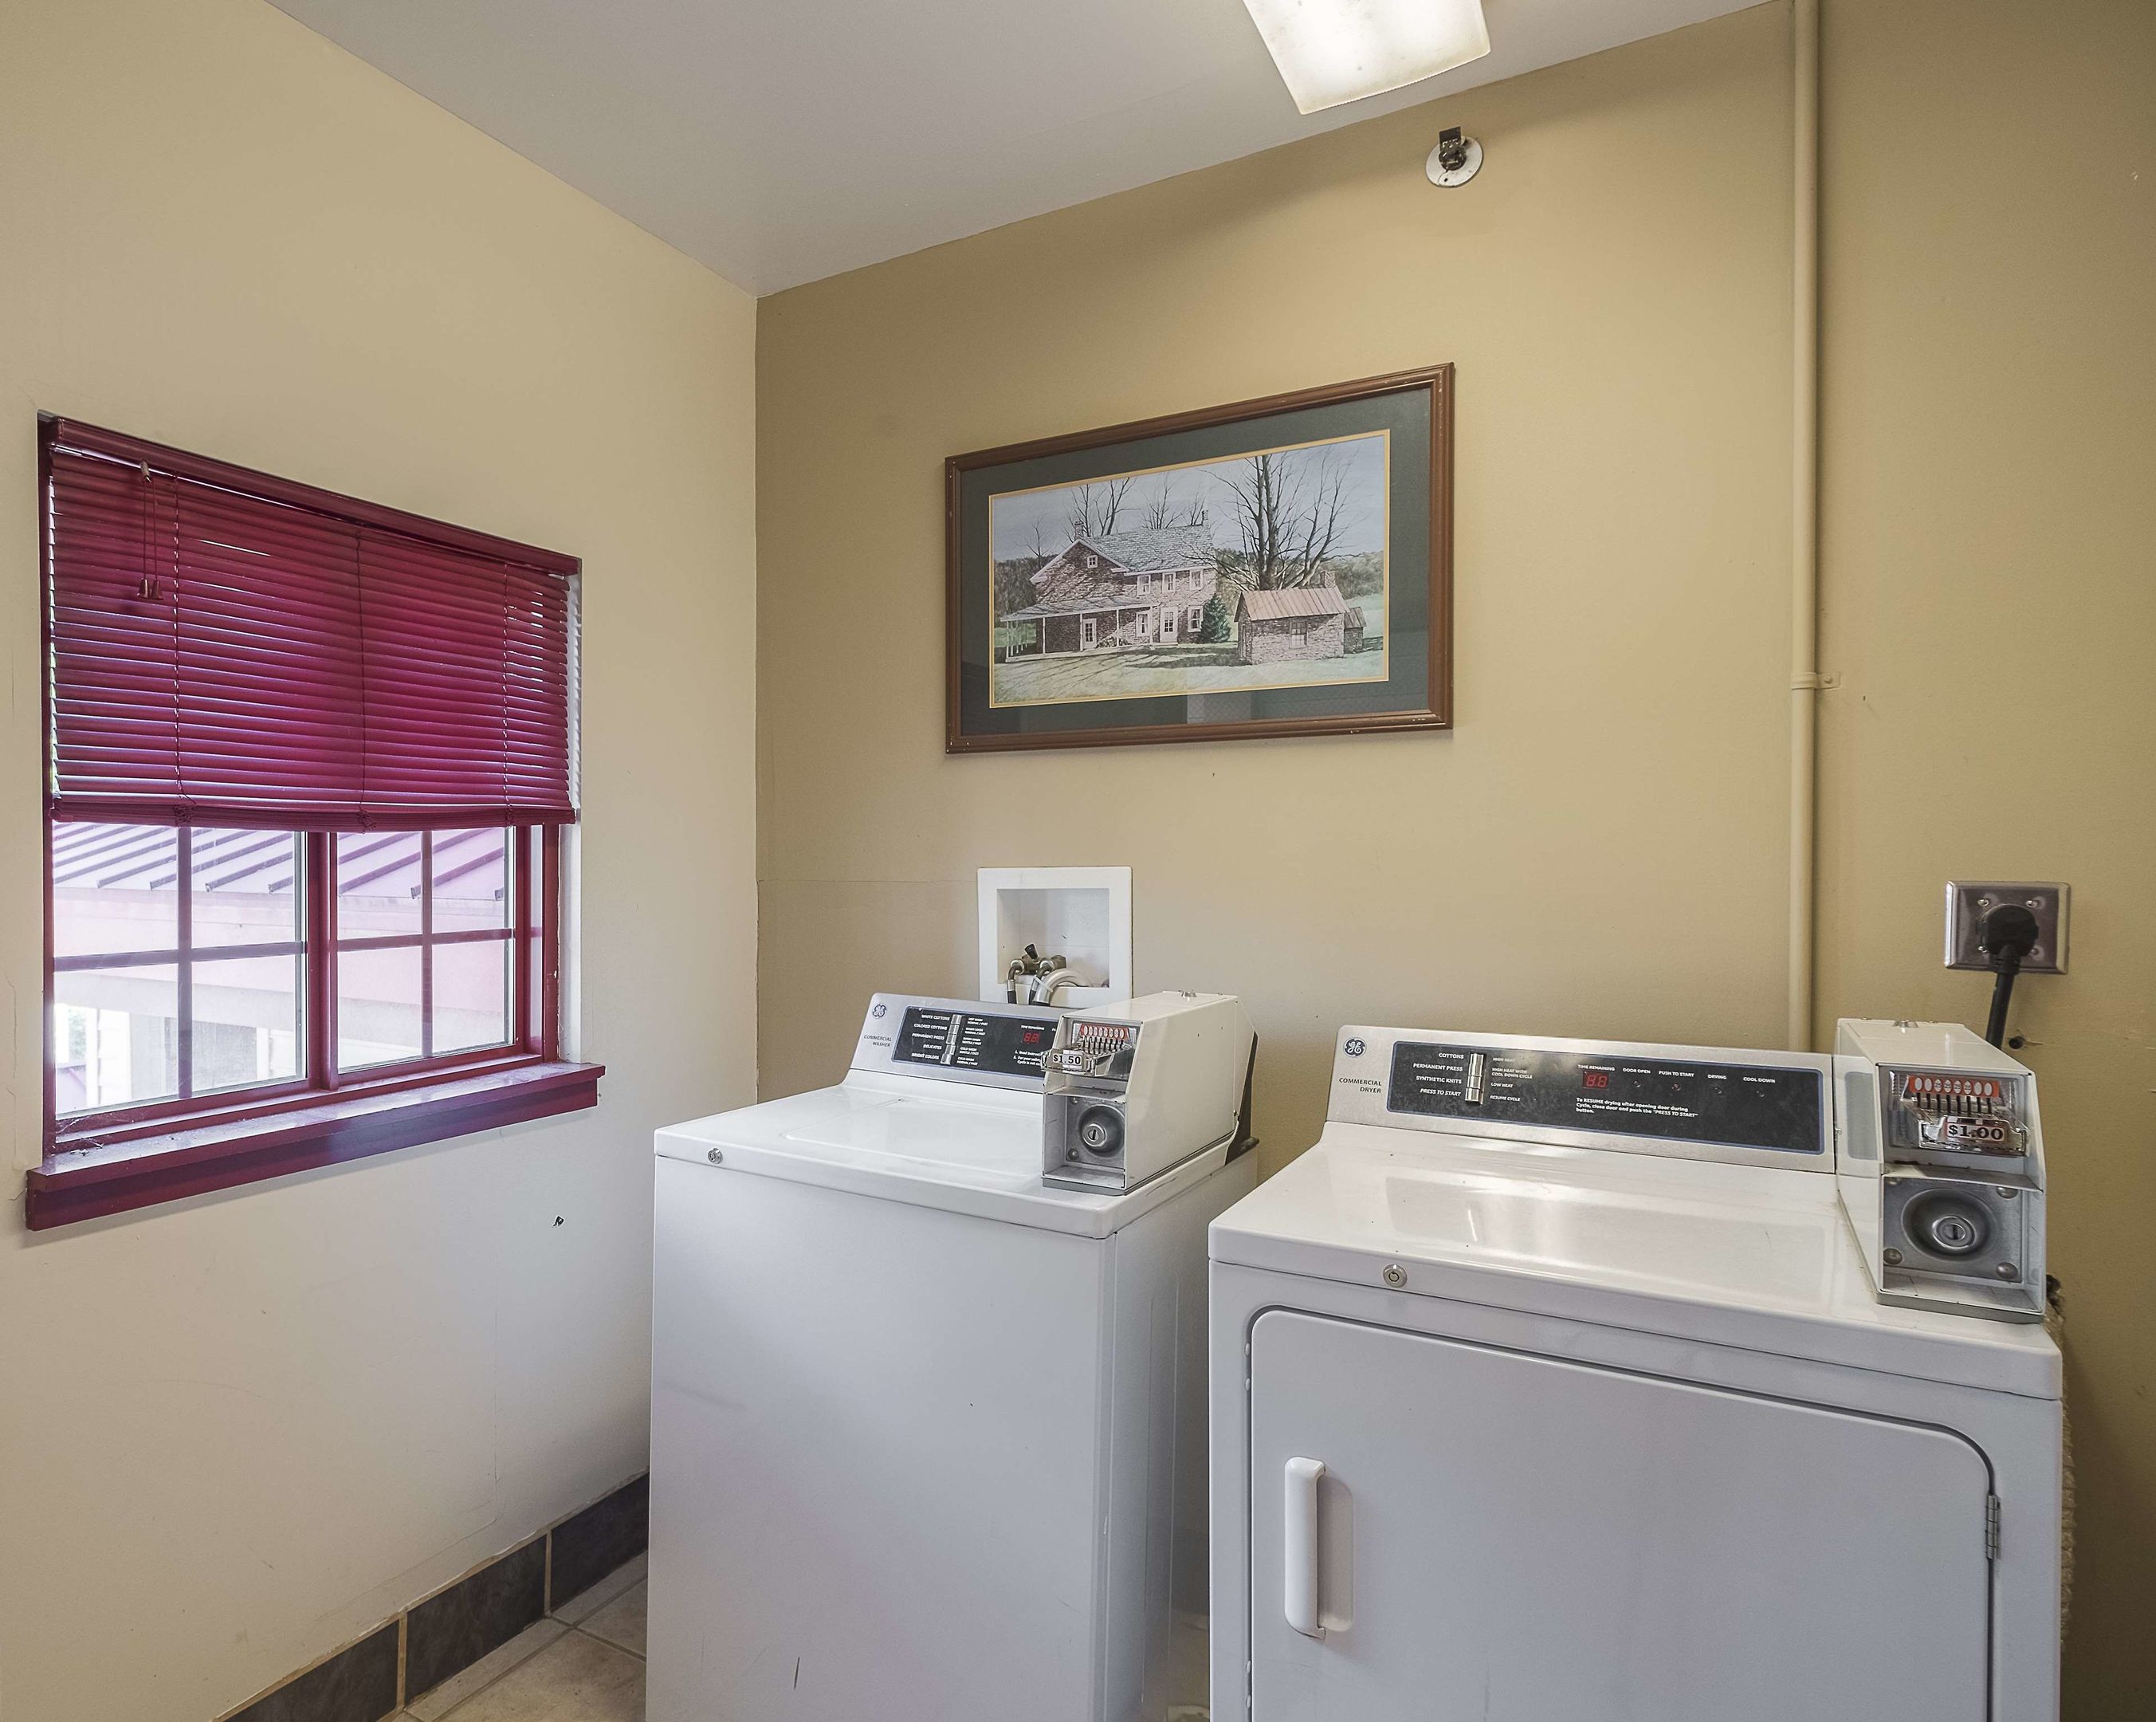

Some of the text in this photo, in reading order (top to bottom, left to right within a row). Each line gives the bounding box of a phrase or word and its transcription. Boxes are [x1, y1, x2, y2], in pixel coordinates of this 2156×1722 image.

[1343, 1037, 1366, 1058] GE
[1053, 1054, 1081, 1064] $1.50
[1339, 1077, 1382, 1086] COMMERCIAL
[1948, 1124, 2005, 1140] $1.00
